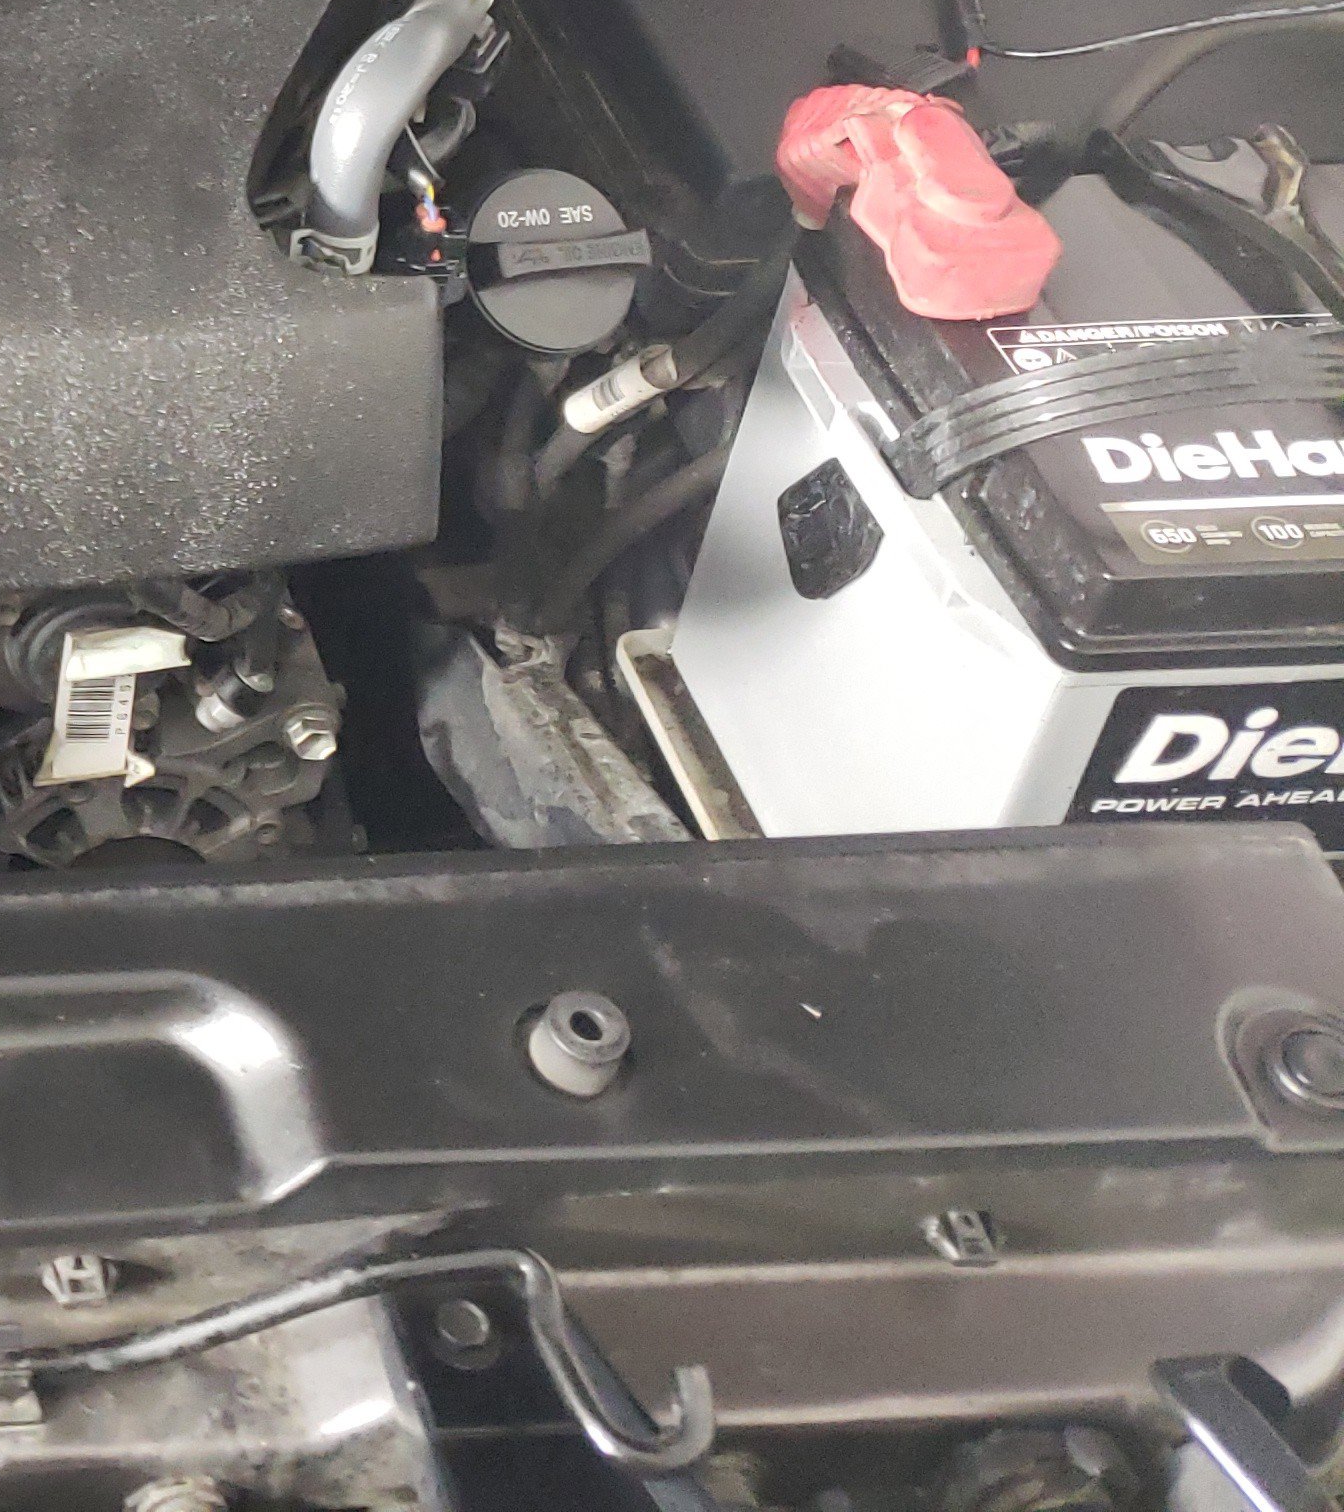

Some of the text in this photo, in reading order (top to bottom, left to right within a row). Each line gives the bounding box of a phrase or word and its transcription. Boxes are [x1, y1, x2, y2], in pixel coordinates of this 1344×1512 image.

[497, 204, 594, 228] SAE 0W-20
[1033, 323, 1229, 344] DANGER/POISON
[1148, 527, 1197, 544] 650
[1257, 523, 1304, 541] 100
[1090, 795, 1228, 813] POWER
